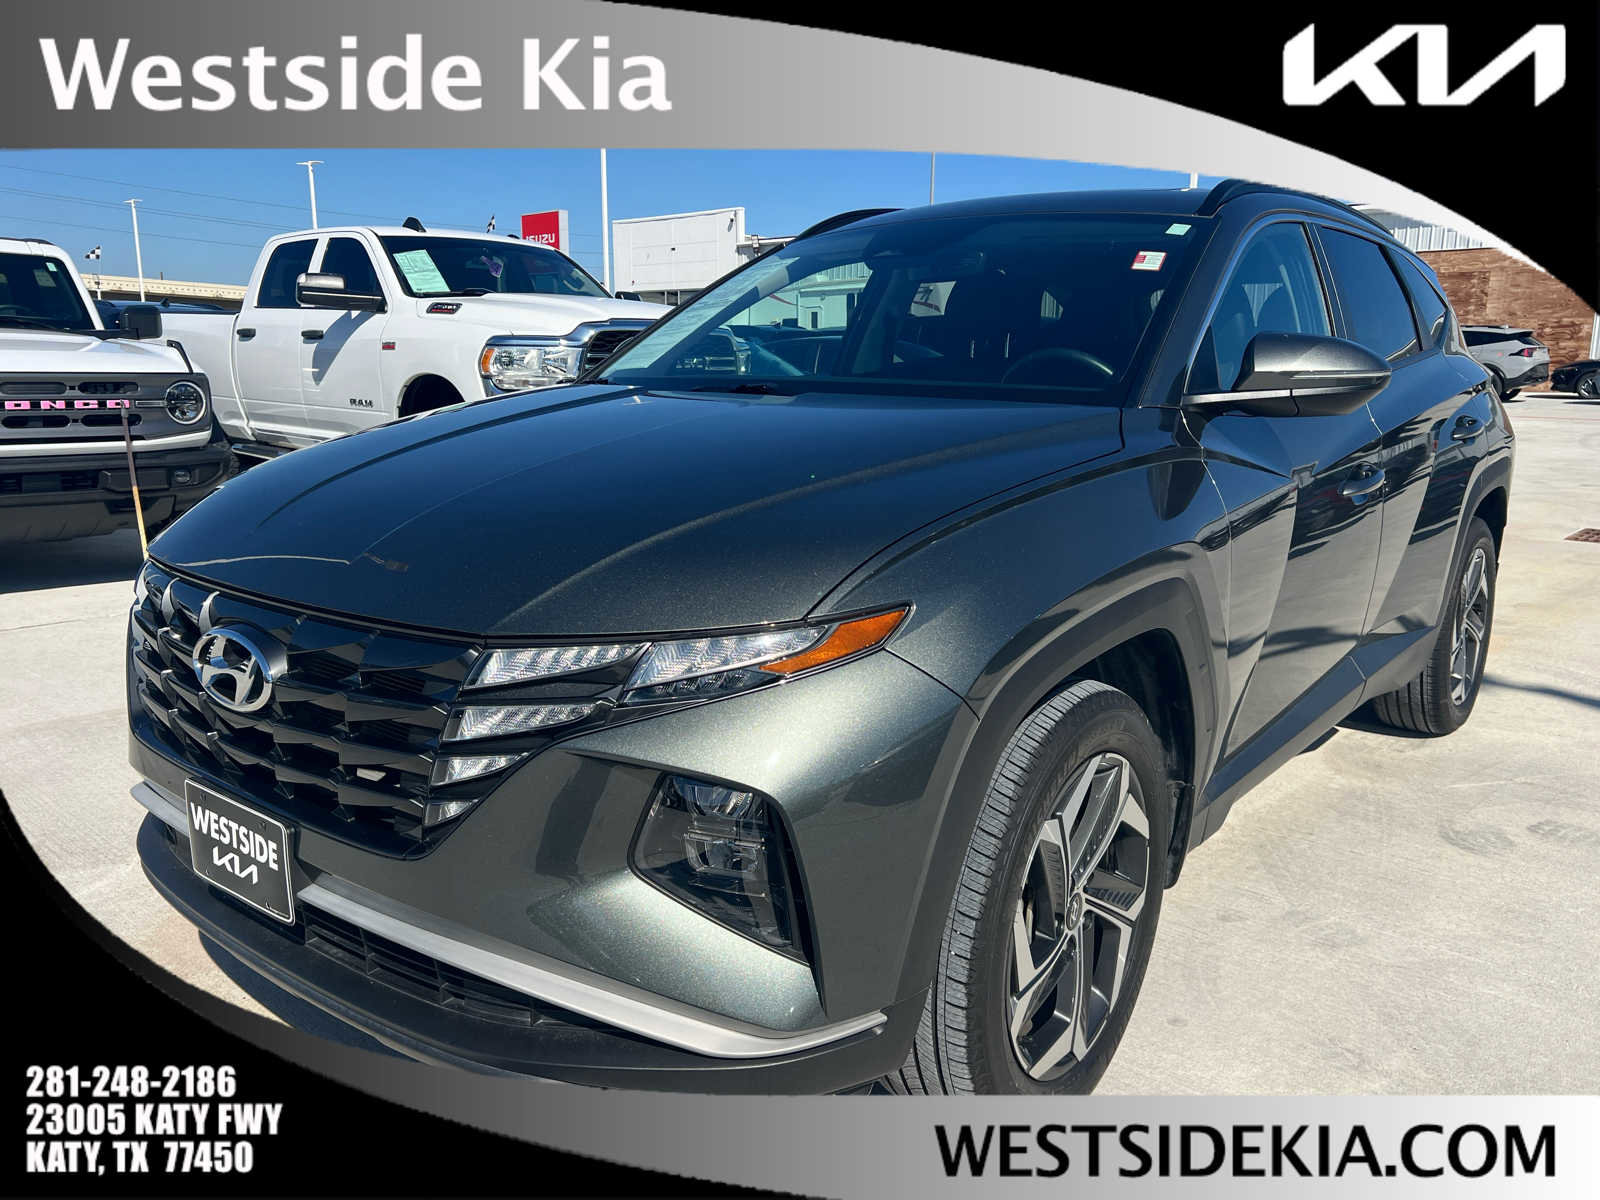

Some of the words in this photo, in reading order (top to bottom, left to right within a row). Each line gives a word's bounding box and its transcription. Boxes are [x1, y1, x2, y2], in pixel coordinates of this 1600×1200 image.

[349, 398, 374, 408] RAM
[190, 801, 279, 871] WESTSIDE
[212, 846, 258, 885] KIA
